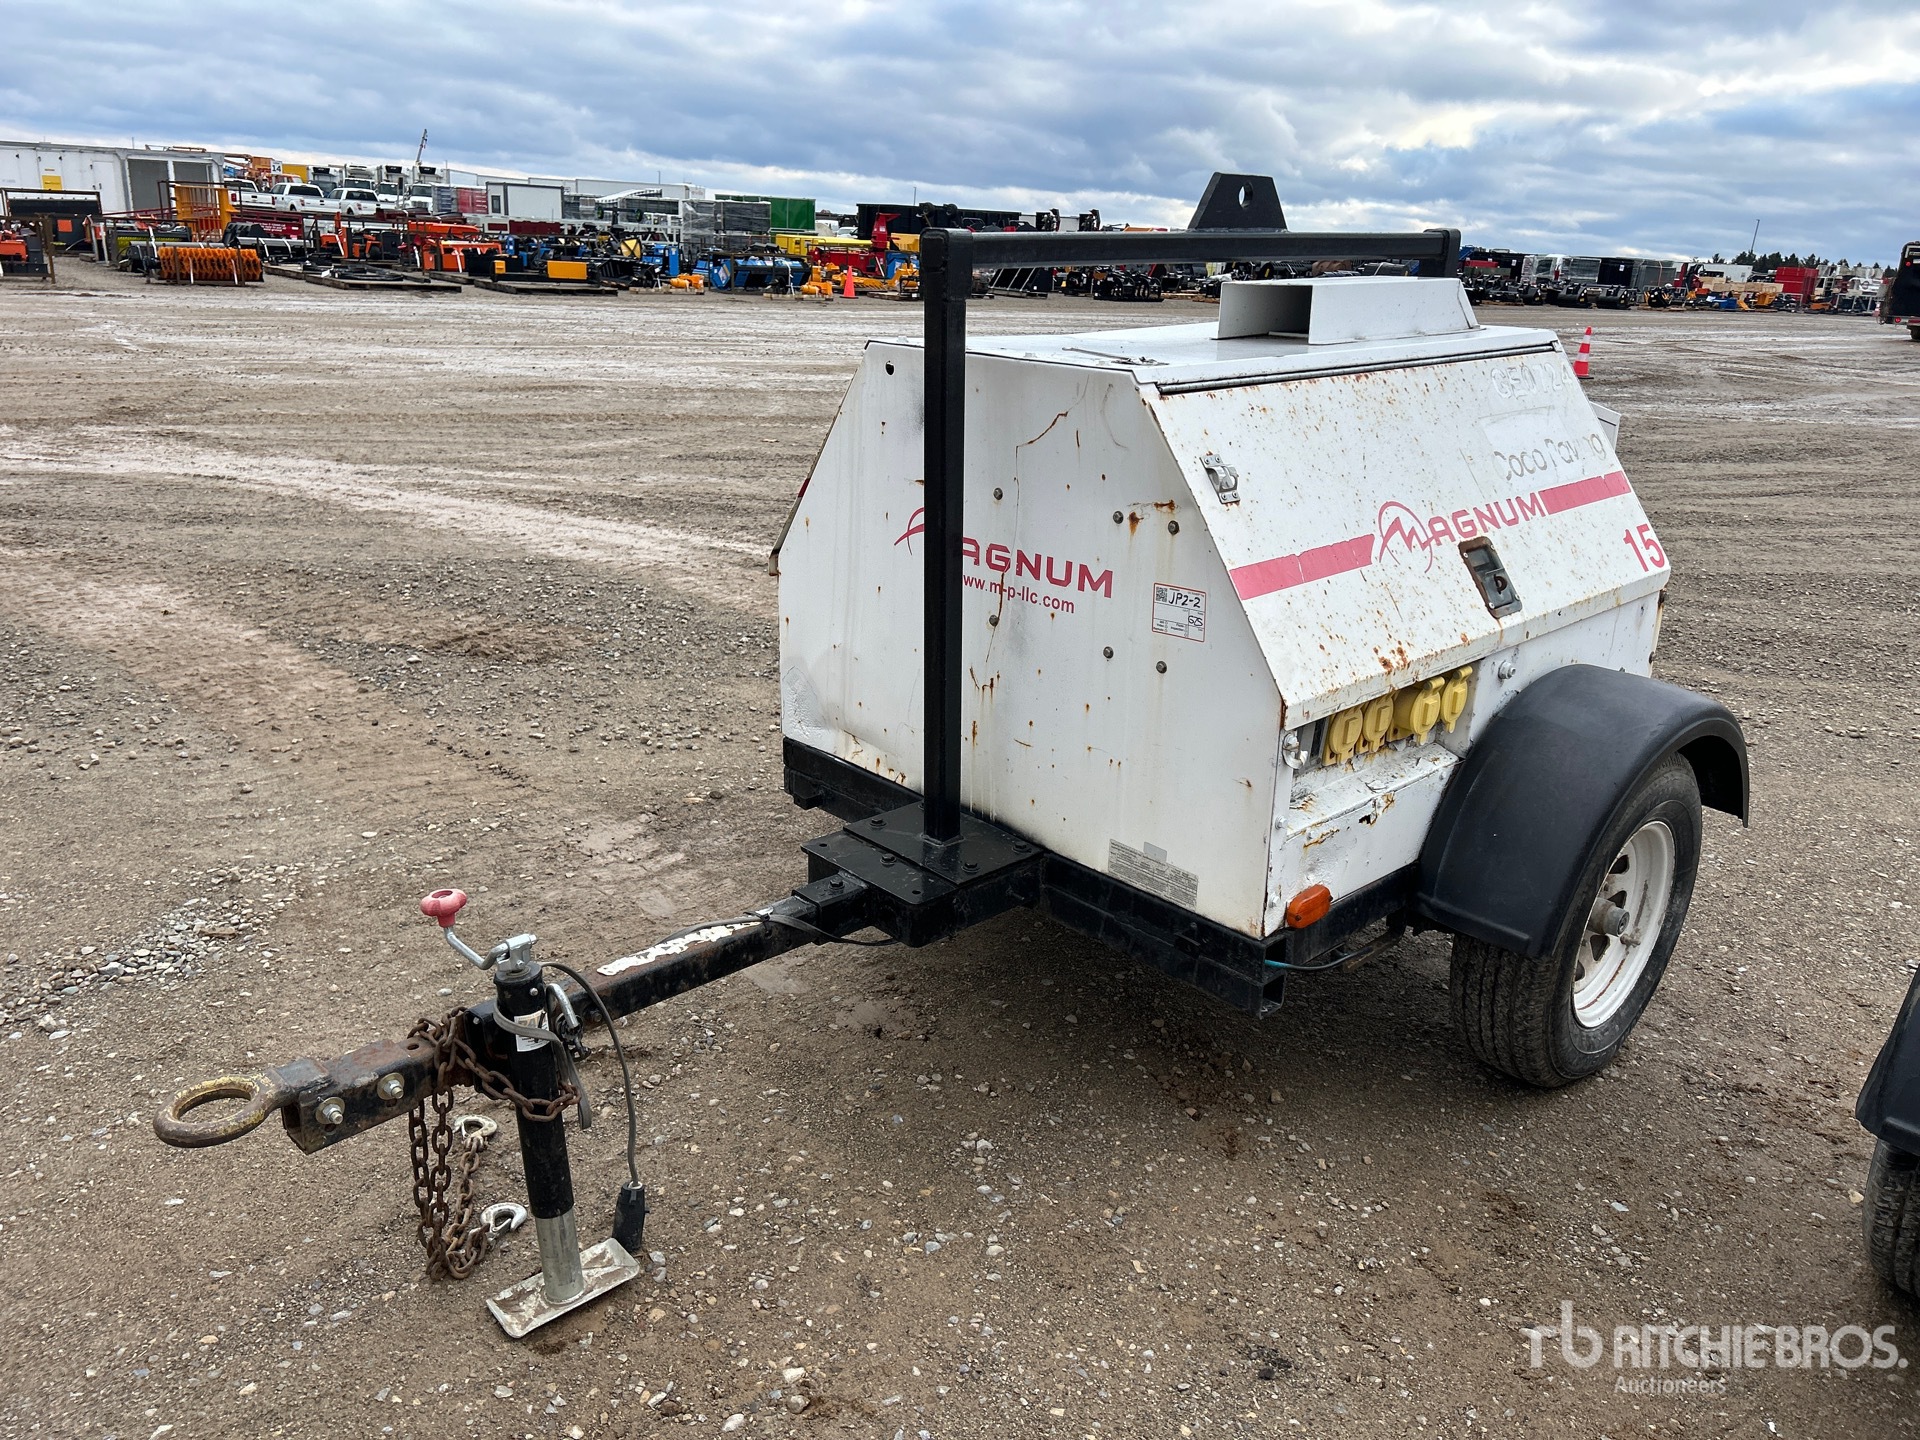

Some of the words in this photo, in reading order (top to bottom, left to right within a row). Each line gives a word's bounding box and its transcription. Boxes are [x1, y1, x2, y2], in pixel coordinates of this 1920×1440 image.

[1379, 490, 1547, 566] MAGNUM
[1623, 523, 1666, 572] 15
[963, 575, 1075, 614] ww.m-p-llc.com
[1168, 592, 1201, 608] JP2-2
